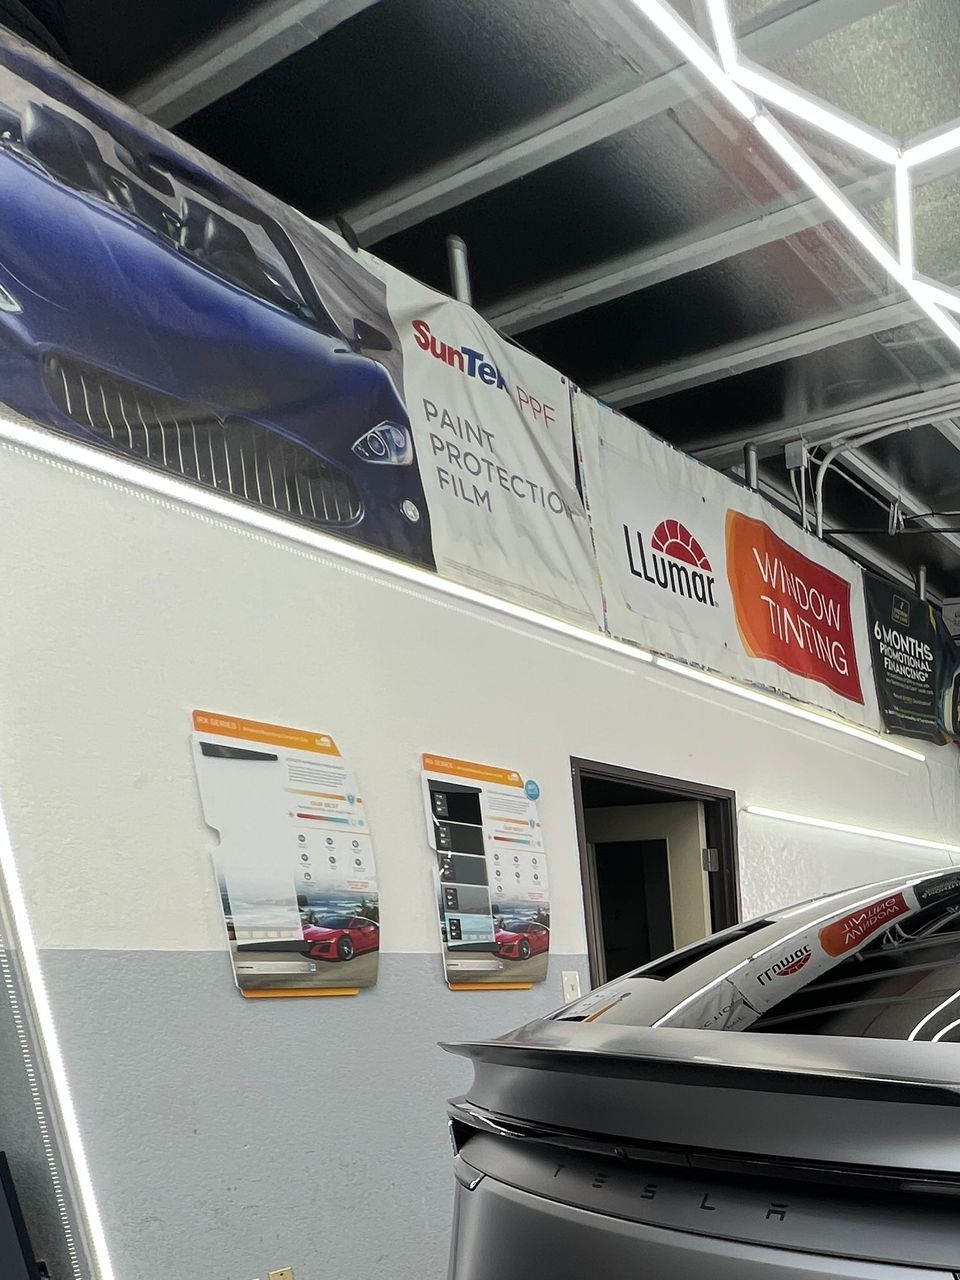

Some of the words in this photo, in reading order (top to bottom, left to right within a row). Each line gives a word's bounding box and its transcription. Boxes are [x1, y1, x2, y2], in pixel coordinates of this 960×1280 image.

[423, 399, 495, 453] PAINT
[516, 386, 556, 428] PPF
[437, 467, 492, 513] FILM
[623, 524, 715, 607] LLumar
[752, 547, 841, 632] WINDOW
[761, 595, 849, 677] TINTING
[874, 621, 882, 641] 6
[882, 624, 934, 662] MONTHS
[879, 641, 932, 672] PROMOTIONAL
